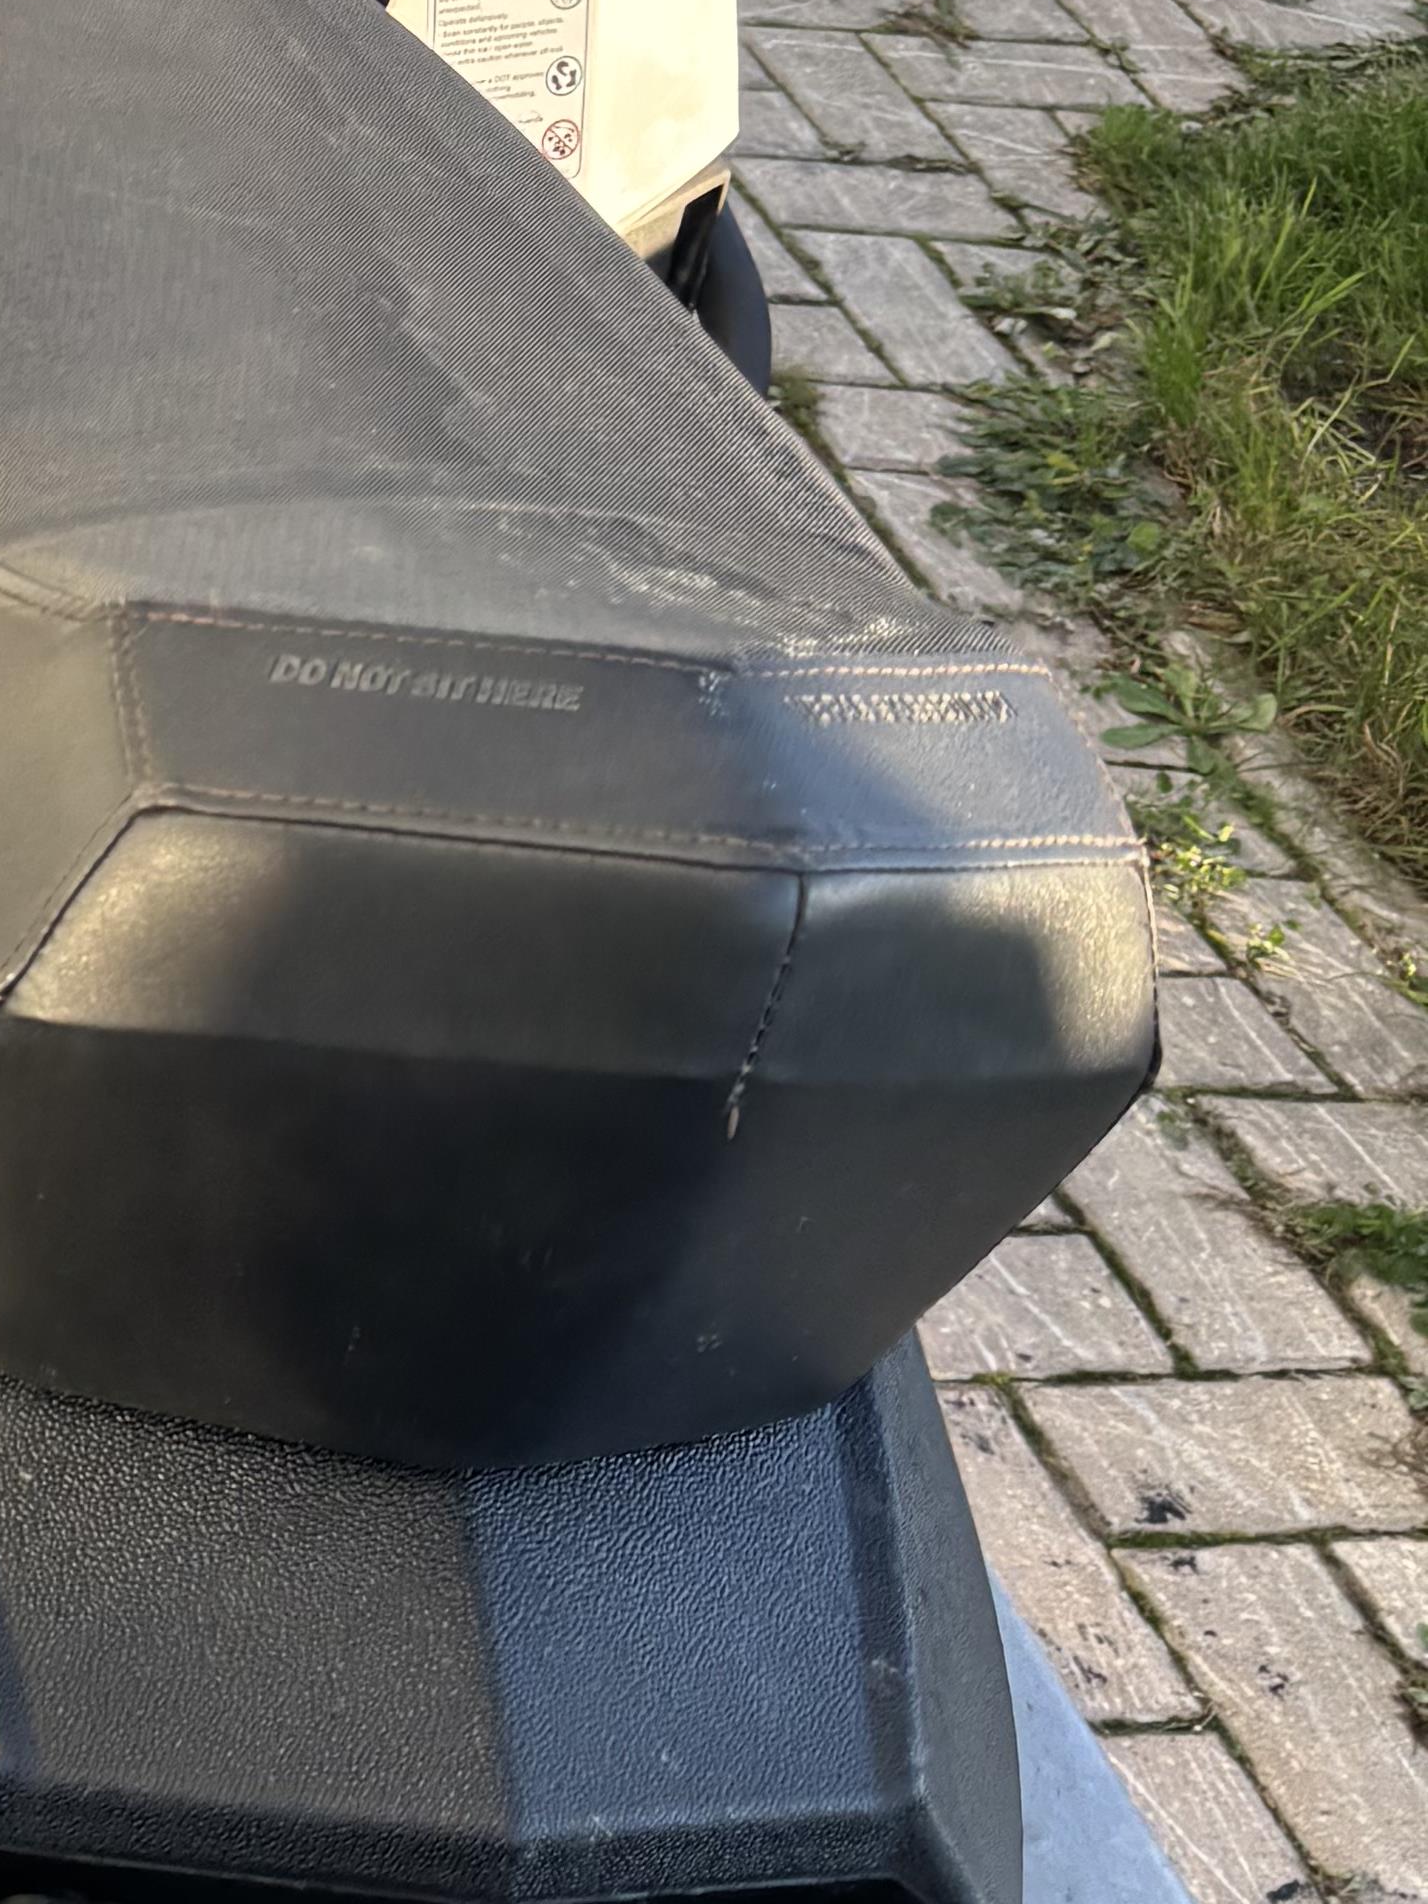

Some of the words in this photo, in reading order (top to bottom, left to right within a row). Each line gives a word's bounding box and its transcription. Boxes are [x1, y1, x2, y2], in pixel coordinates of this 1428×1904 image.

[269, 653, 326, 686] DO
[330, 659, 412, 695] NOT
[475, 676, 584, 711] HERE
